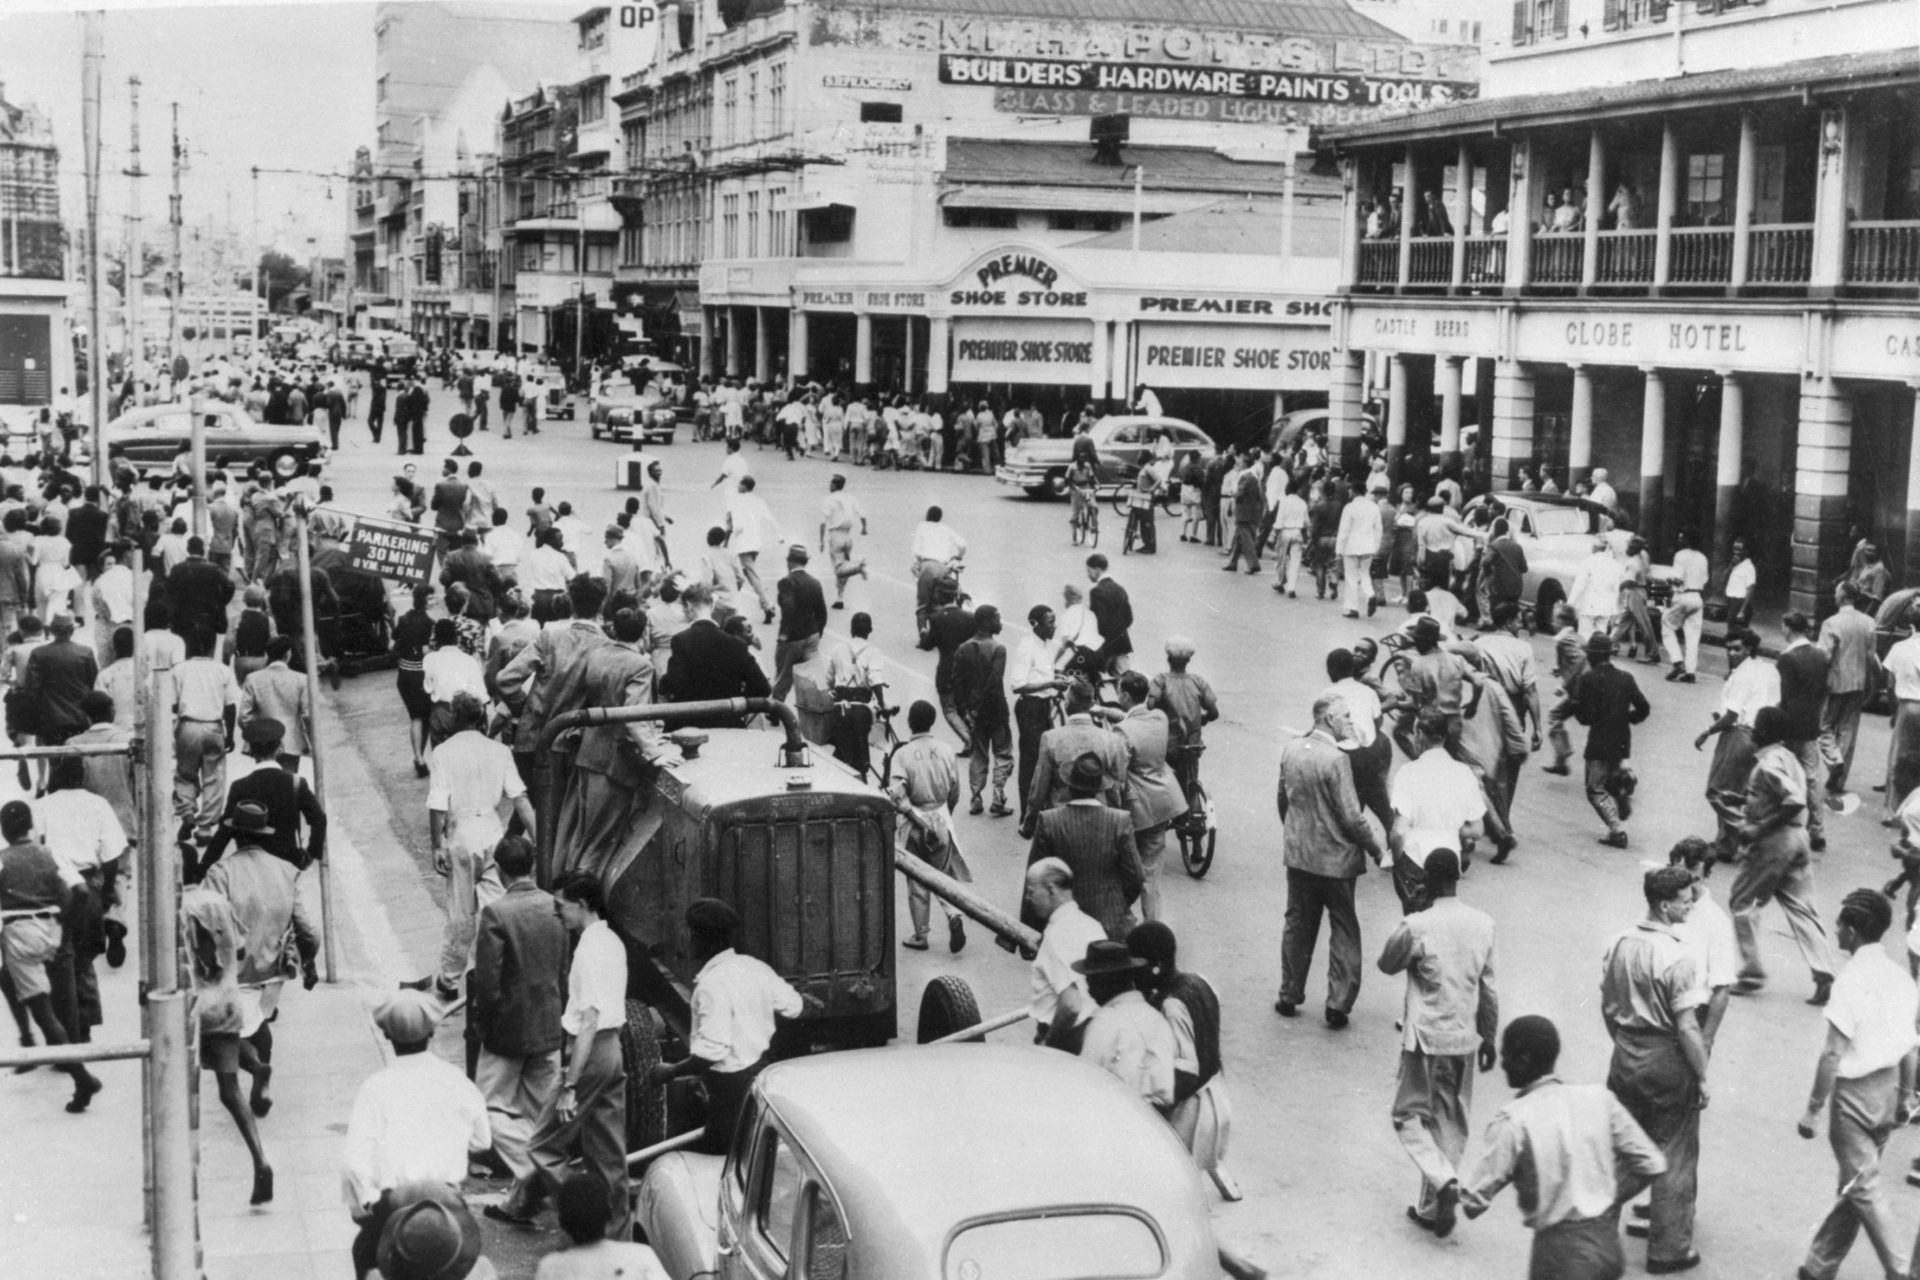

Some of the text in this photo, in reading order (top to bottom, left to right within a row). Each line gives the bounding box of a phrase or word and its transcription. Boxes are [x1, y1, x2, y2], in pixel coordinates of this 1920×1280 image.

[1099, 65, 1246, 95] HARDWARE
[1260, 75, 1350, 101] PAINTS
[1364, 81, 1454, 105] TOOLS
[1001, 90, 1076, 112] GLASS
[1089, 94, 1106, 113] &
[1116, 94, 1211, 117] LEADED
[977, 254, 1057, 289] PREMIER
[802, 292, 925, 307] PREMIER SHOE STORE
[950, 291, 1088, 306] SHOE STORE
[1140, 297, 1273, 315] PREMIER
[1375, 318, 1469, 337] CASTLE BEERS
[1566, 322, 1746, 351] GLOBE HOTEL
[959, 339, 1092, 363] PREMIER SHOE STORE
[1147, 345, 1225, 368] PREMIER
[1233, 348, 1280, 369] SHOE
[356, 529, 429, 554] PARKERING
[367, 546, 415, 566] 30 MIN
